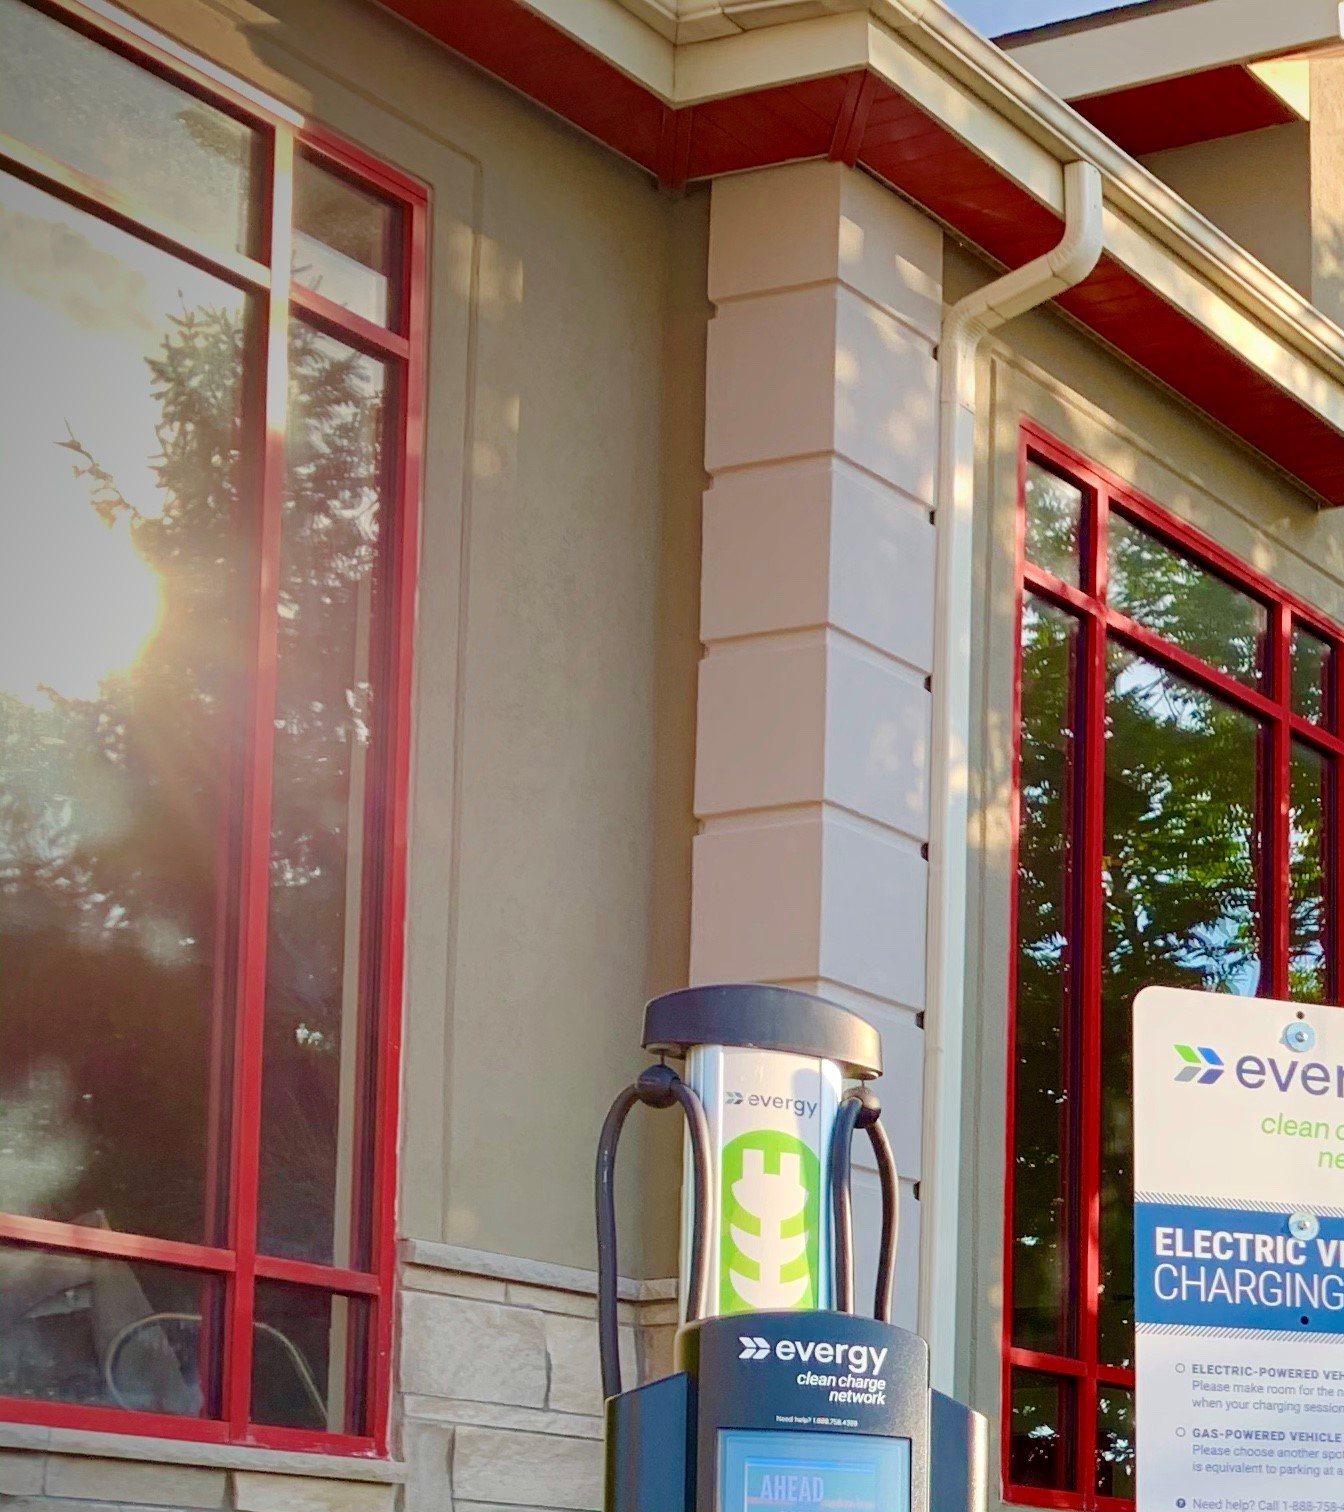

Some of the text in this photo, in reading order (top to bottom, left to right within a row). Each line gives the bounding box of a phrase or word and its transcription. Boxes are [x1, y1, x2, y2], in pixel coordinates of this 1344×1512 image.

[748, 1092, 818, 1119] evergy
[1260, 1112, 1329, 1140] clean
[1155, 1226, 1307, 1266] ELECTRIC
[1153, 1263, 1344, 1311] CHARGING
[775, 1340, 888, 1376] evergy
[1191, 1363, 1319, 1379] ELECTRIC-POWERED
[796, 1371, 886, 1393] clean charge
[1192, 1379, 1230, 1392] Please
[1233, 1382, 1264, 1394] make
[1267, 1385, 1296, 1395] room
[1299, 1384, 1314, 1395] for
[1317, 1386, 1334, 1397] the
[828, 1389, 887, 1405] network
[1191, 1397, 1223, 1409] when
[1225, 1400, 1250, 1411] your
[1252, 1400, 1301, 1413] charging
[1303, 1403, 1344, 1414] session
[1192, 1428, 1286, 1441] GAS-POWERED
[1289, 1432, 1342, 1443] VEHICLE
[1192, 1444, 1231, 1456] Please
[1233, 1447, 1274, 1457] choose
[1277, 1448, 1320, 1458] another
[1192, 1461, 1203, 1472] is
[1205, 1462, 1263, 1474] equivalent
[1266, 1464, 1277, 1474] to
[1279, 1464, 1320, 1477] parking
[1323, 1466, 1334, 1475] at
[1336, 1467, 1344, 1476] a
[760, 1474, 825, 1501] AHEAD
[1192, 1498, 1222, 1510] Need
[1225, 1499, 1256, 1512] help?
[1258, 1500, 1279, 1511] Call
